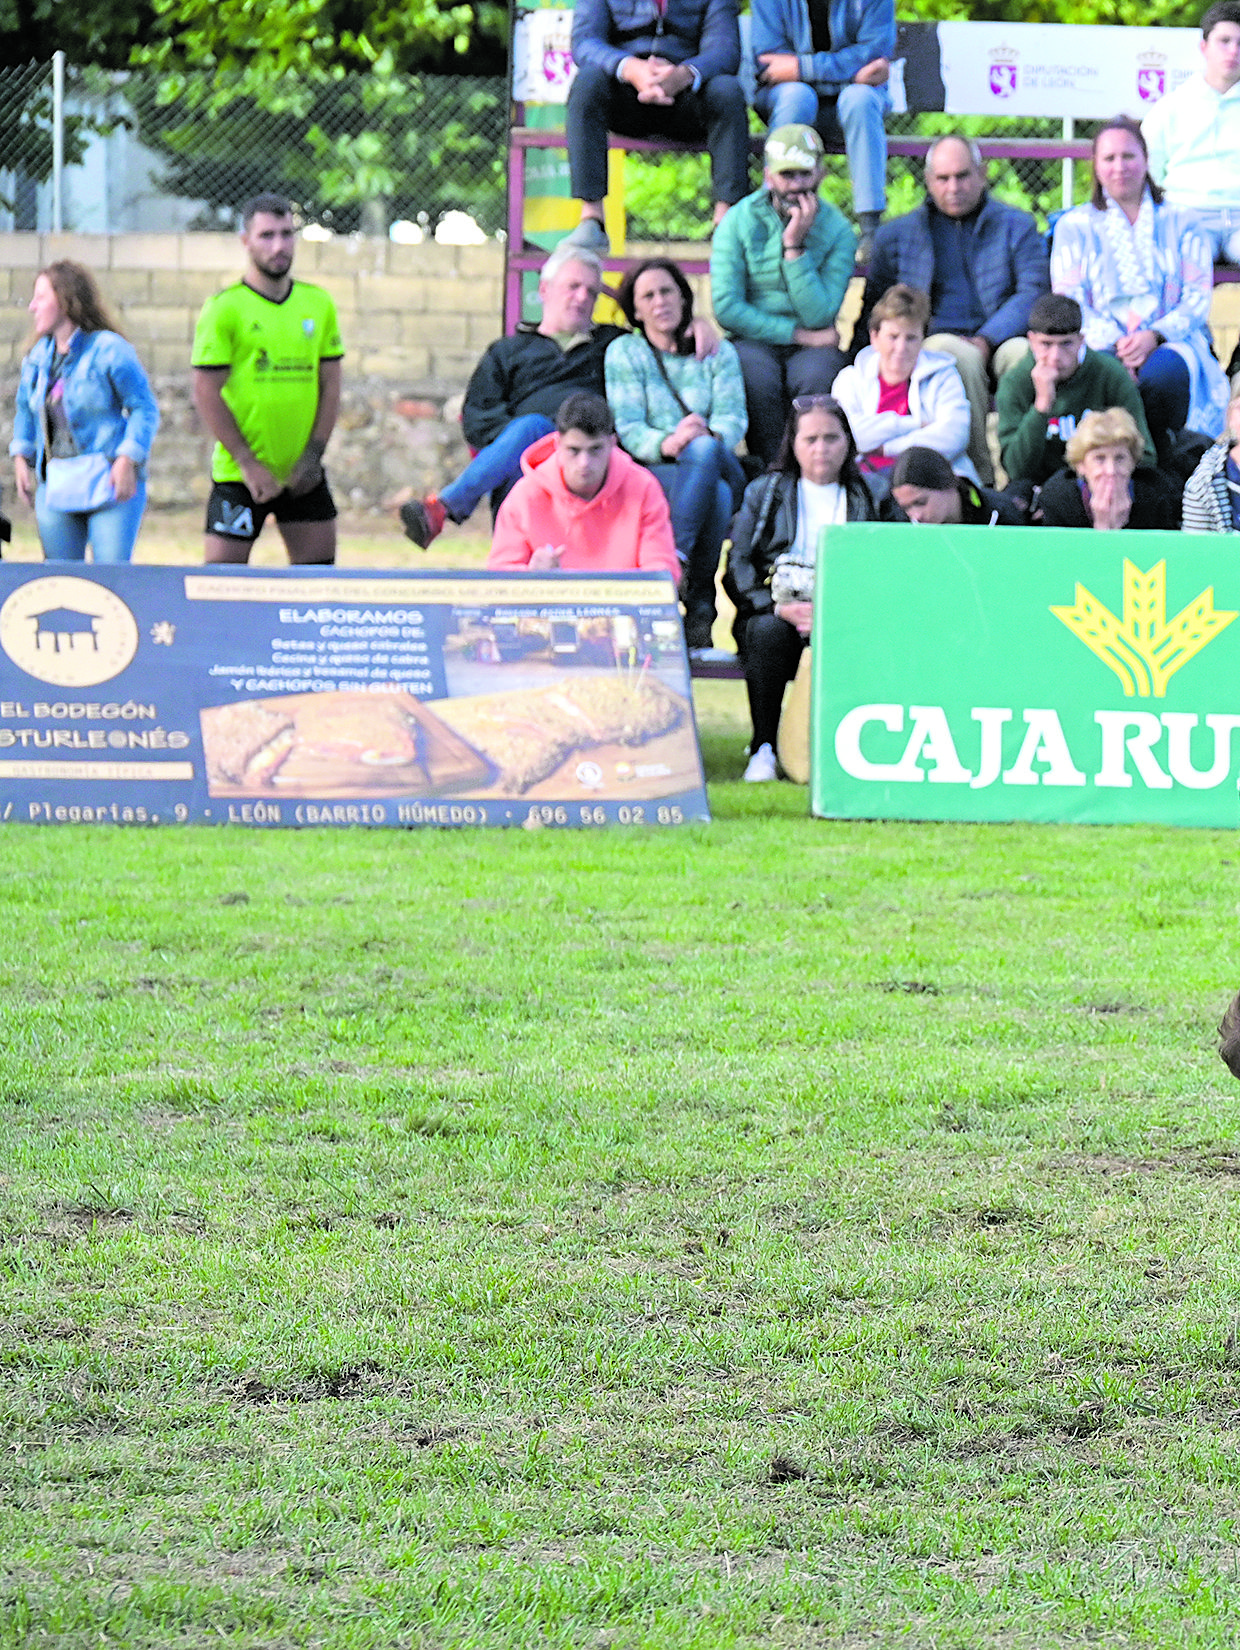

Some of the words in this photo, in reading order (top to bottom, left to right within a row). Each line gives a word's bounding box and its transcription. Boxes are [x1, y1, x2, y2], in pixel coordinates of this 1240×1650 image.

[279, 608, 425, 625] ELABORAMOS
[320, 624, 400, 638] CACHOPOS
[230, 678, 244, 691] Y
[245, 678, 337, 692] CACHOPOS
[338, 680, 367, 694] SIN
[368, 681, 434, 695] GLUTEN
[0, 701, 30, 718] EL
[33, 699, 157, 720] BODEGÓN
[834, 703, 1087, 789] CAJA
[174, 803, 188, 822] 9
[228, 801, 282, 823] LEÓN
[295, 803, 387, 824] (BARRIO
[398, 801, 488, 823] HÚMEDO)
[618, 804, 645, 824] 02
